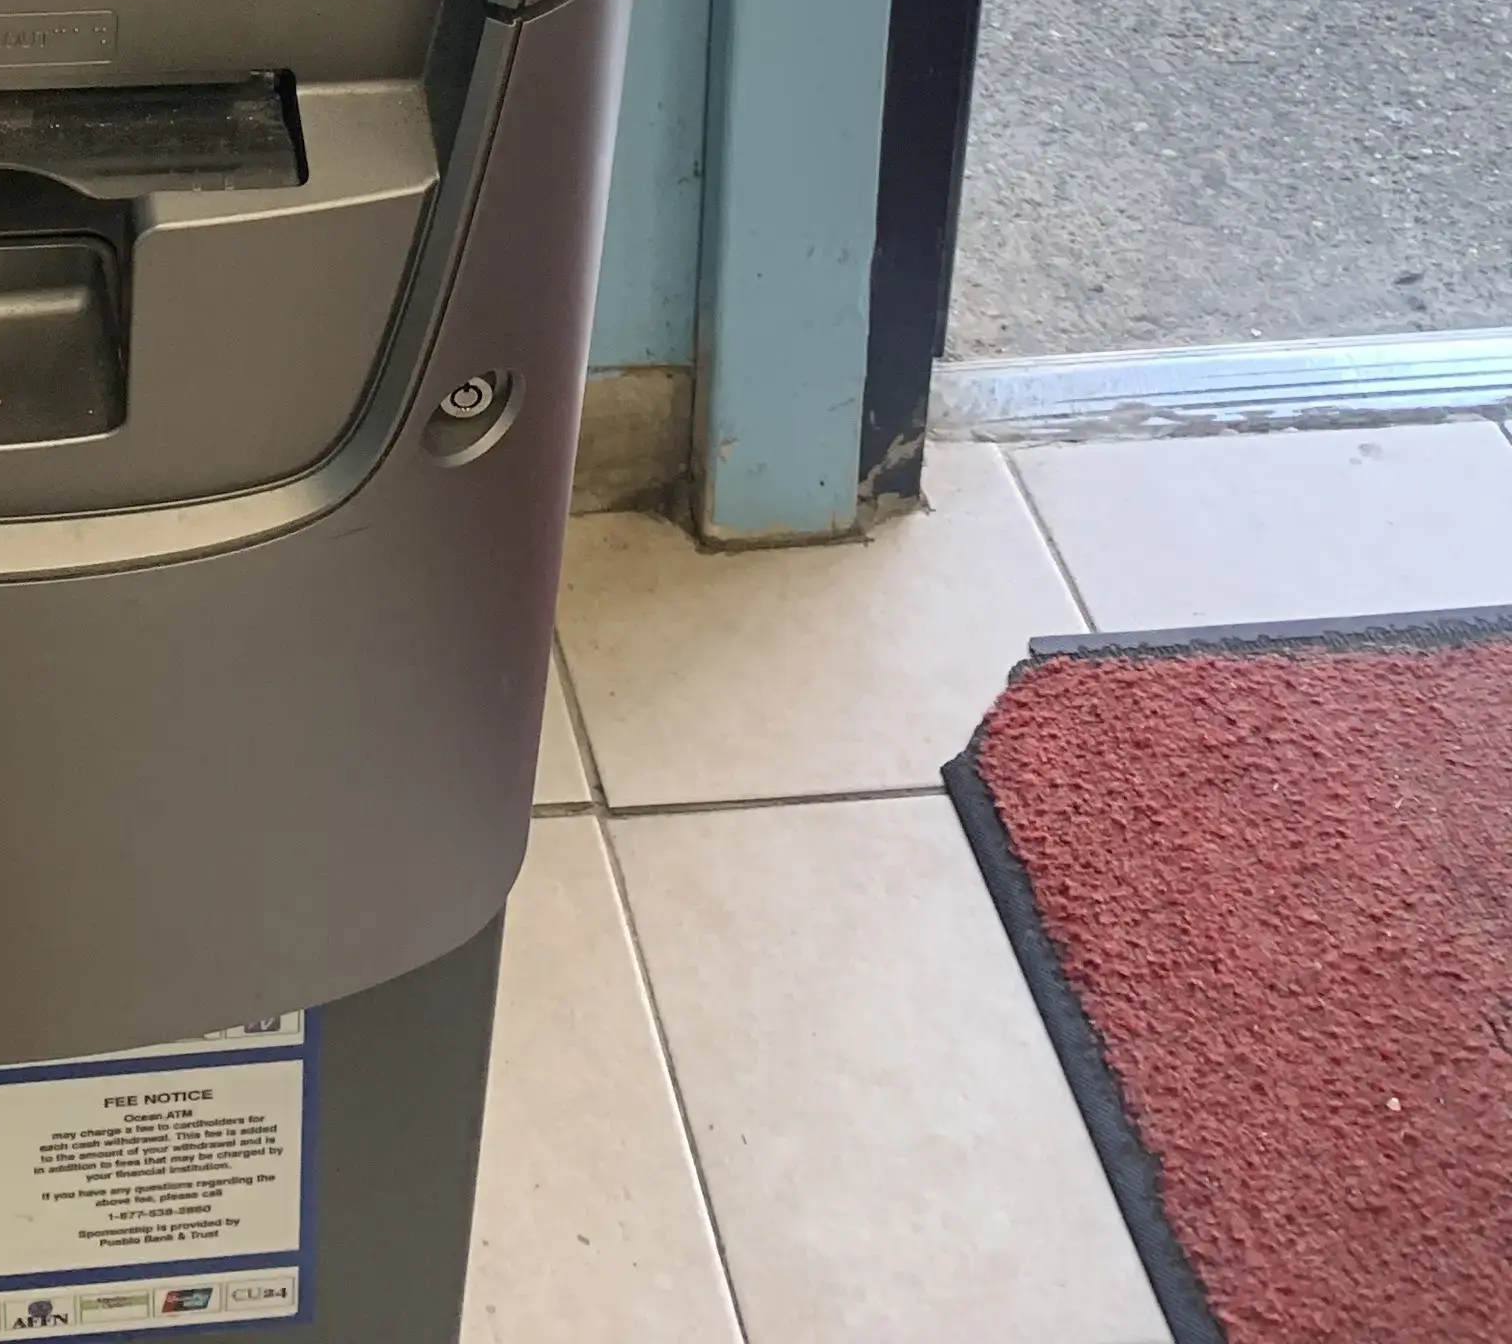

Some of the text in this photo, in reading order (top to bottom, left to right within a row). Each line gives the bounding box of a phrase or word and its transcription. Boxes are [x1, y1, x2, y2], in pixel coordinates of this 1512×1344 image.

[104, 1089, 213, 1108] FEE NOTICE
[123, 1109, 192, 1122] Ocean ATM
[52, 1130, 75, 1140] may
[173, 1117, 244, 1129] cardholders
[248, 1115, 264, 1123] for
[176, 1132, 200, 1141] This
[240, 1125, 277, 1135] added
[78, 1147, 123, 1159] amount
[240, 1137, 261, 1146] and
[100, 1160, 112, 1168] to
[170, 1154, 193, 1162] may
[198, 1151, 212, 1160] be
[217, 1146, 264, 1158] charged
[268, 1146, 283, 1155] by
[86, 1171, 112, 1182] your
[54, 1192, 74, 1201] you
[78, 1189, 106, 1198] have
[196, 1176, 253, 1188] regarding
[256, 1174, 275, 1182] the
[170, 1219, 221, 1232] provided
[224, 1217, 239, 1227] by
[177, 1231, 186, 1240] &
